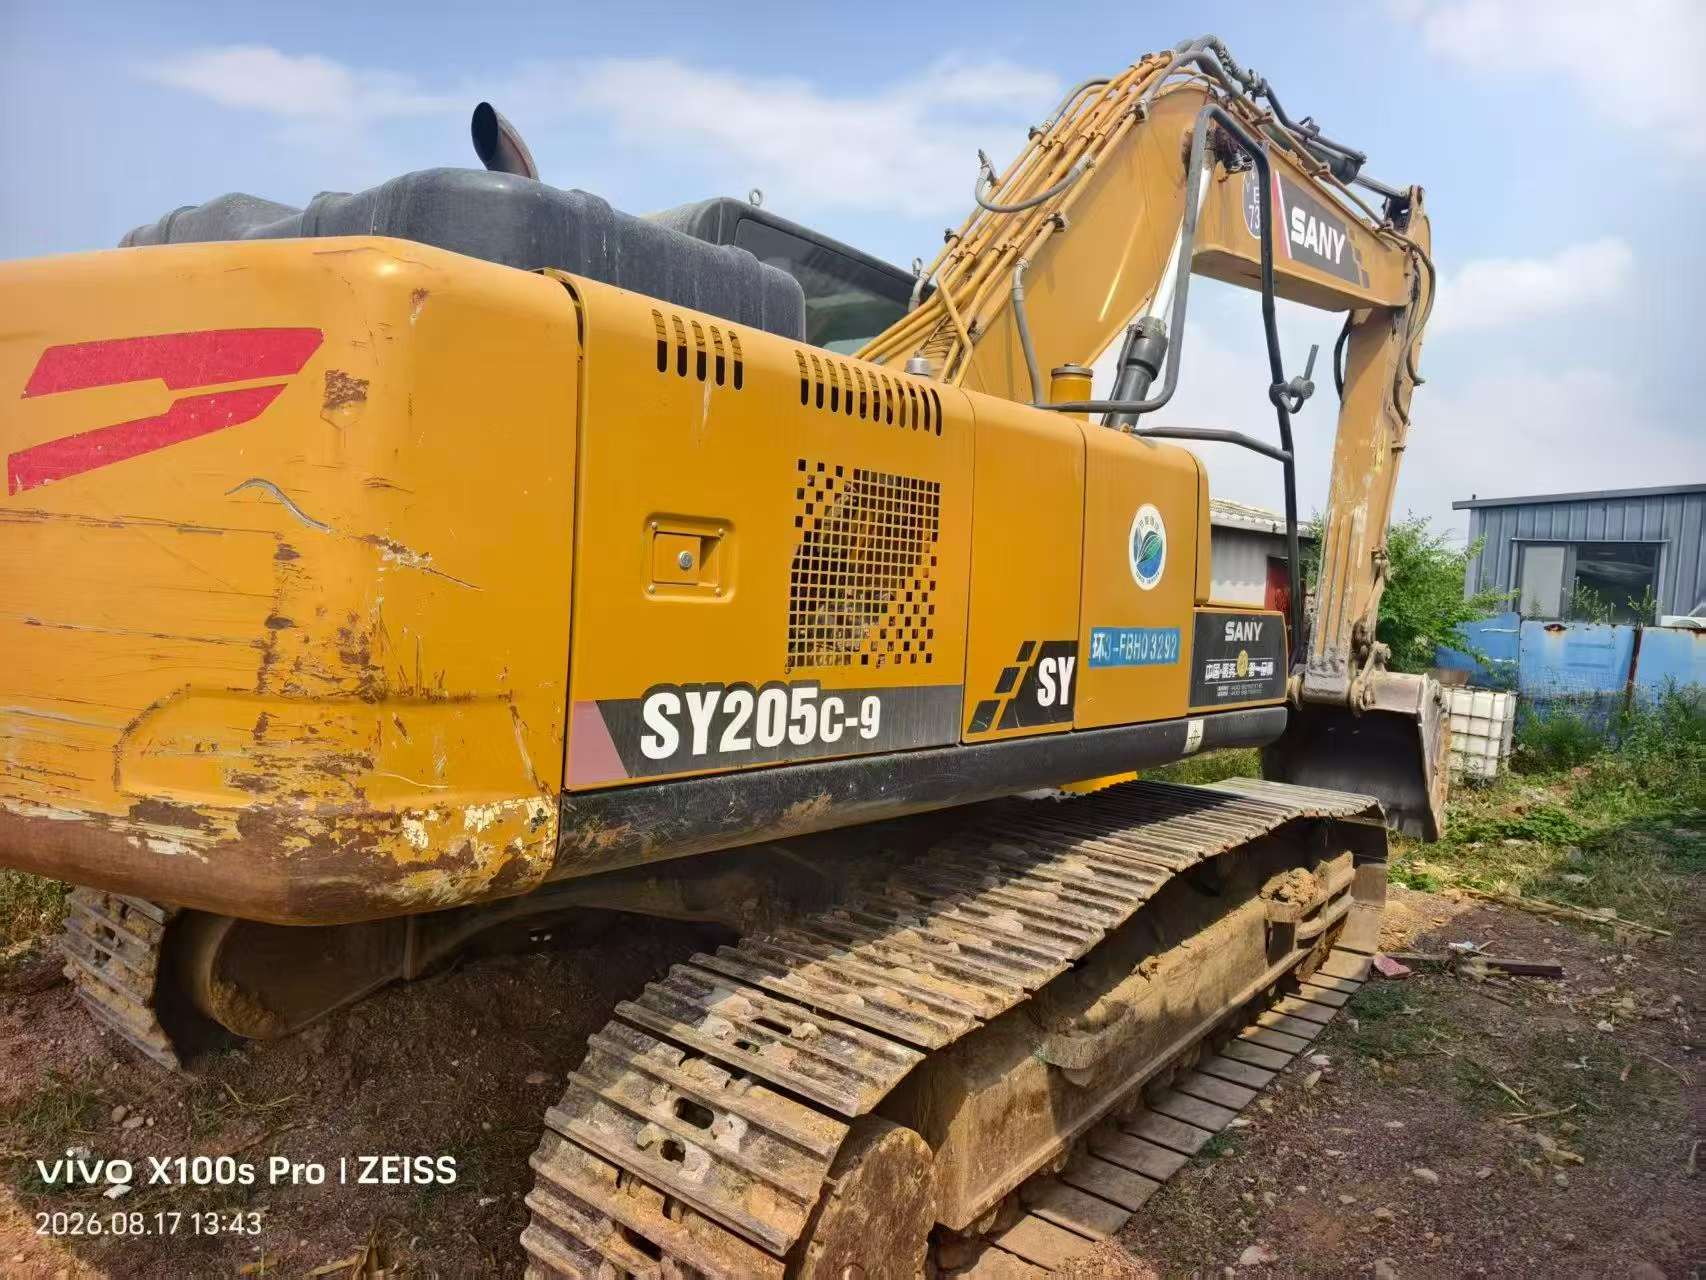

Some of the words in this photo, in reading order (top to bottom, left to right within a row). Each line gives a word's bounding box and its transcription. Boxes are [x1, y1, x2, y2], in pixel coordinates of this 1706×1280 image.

[1291, 206, 1346, 264] SANY
[1225, 620, 1263, 643] SANY
[1037, 656, 1076, 707] SY
[639, 686, 881, 760] SY205C-9
